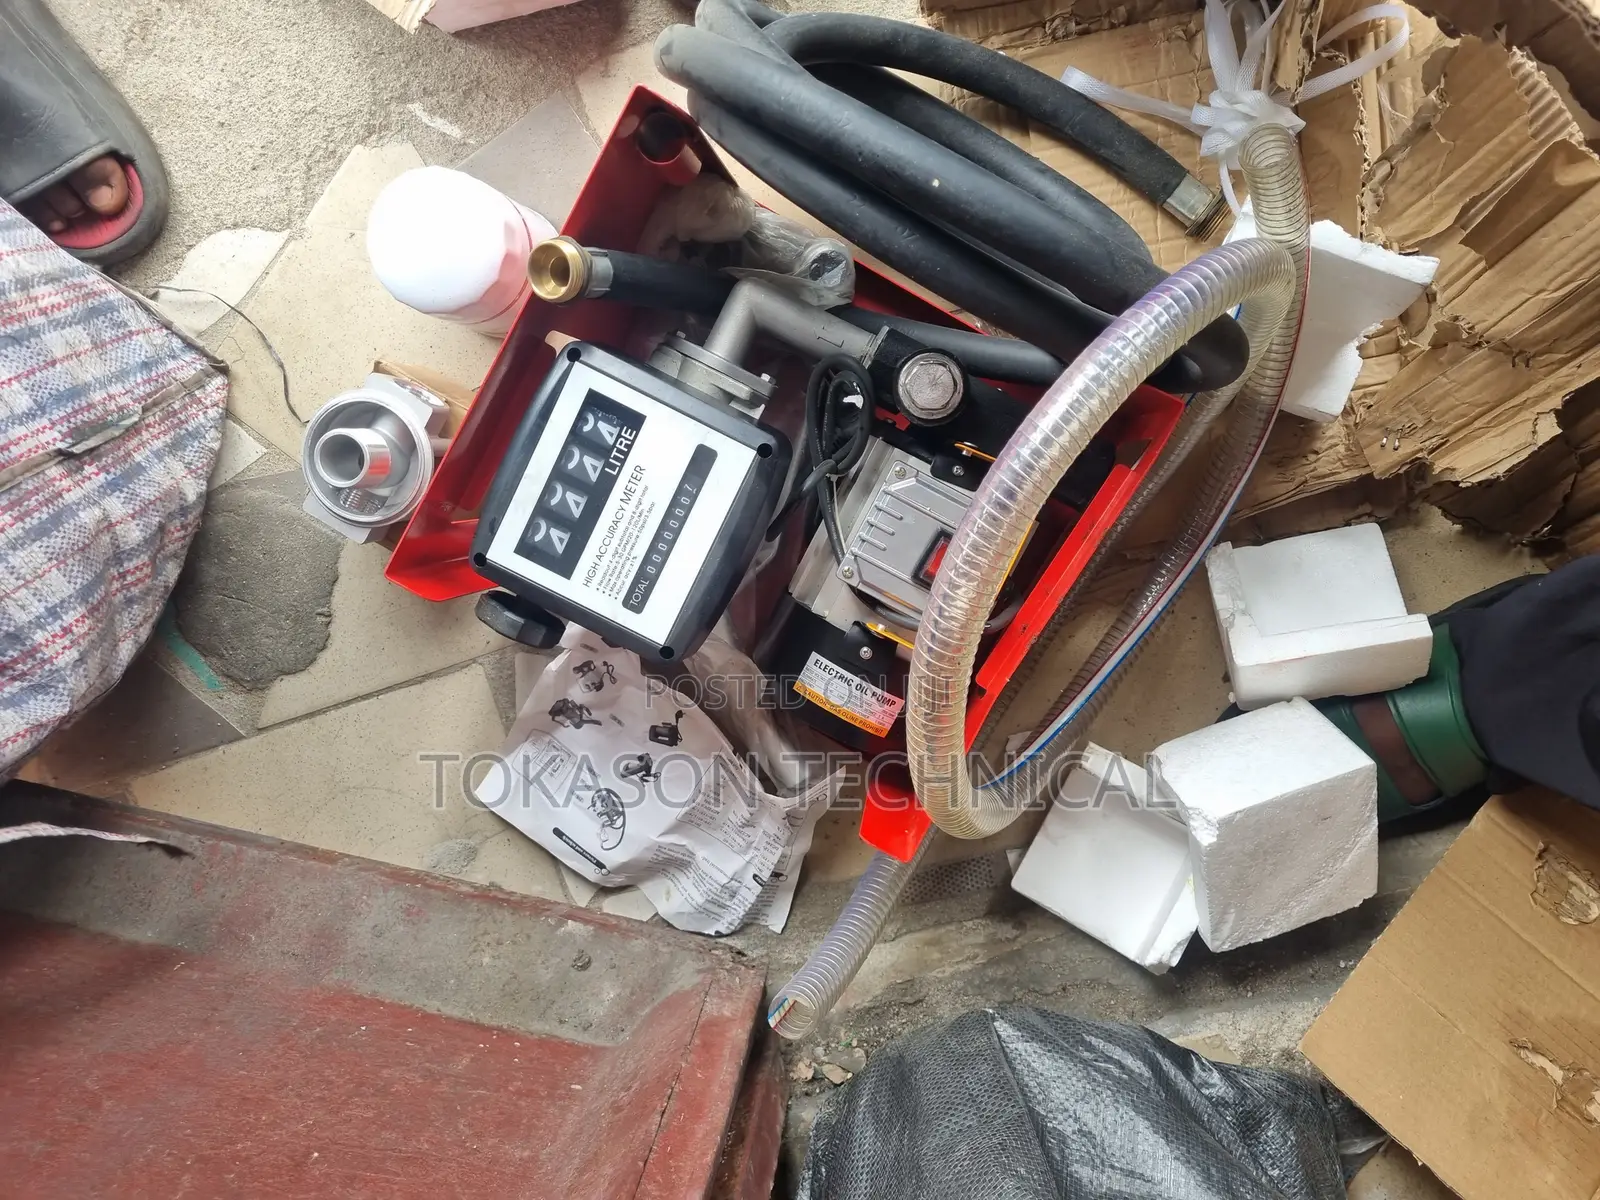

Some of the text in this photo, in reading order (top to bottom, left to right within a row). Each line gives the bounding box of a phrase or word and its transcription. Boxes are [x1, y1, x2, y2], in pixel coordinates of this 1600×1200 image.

[605, 425, 636, 475] LITRE
[582, 464, 645, 587] HIGH ACCURACY METER
[626, 514, 634, 526] and
[628, 577, 649, 607] TOTAL
[813, 658, 854, 686] ELECTRIC
[854, 682, 870, 695] OIL
[870, 690, 896, 708] PUMP
[858, 719, 882, 734] PROHIBIT
